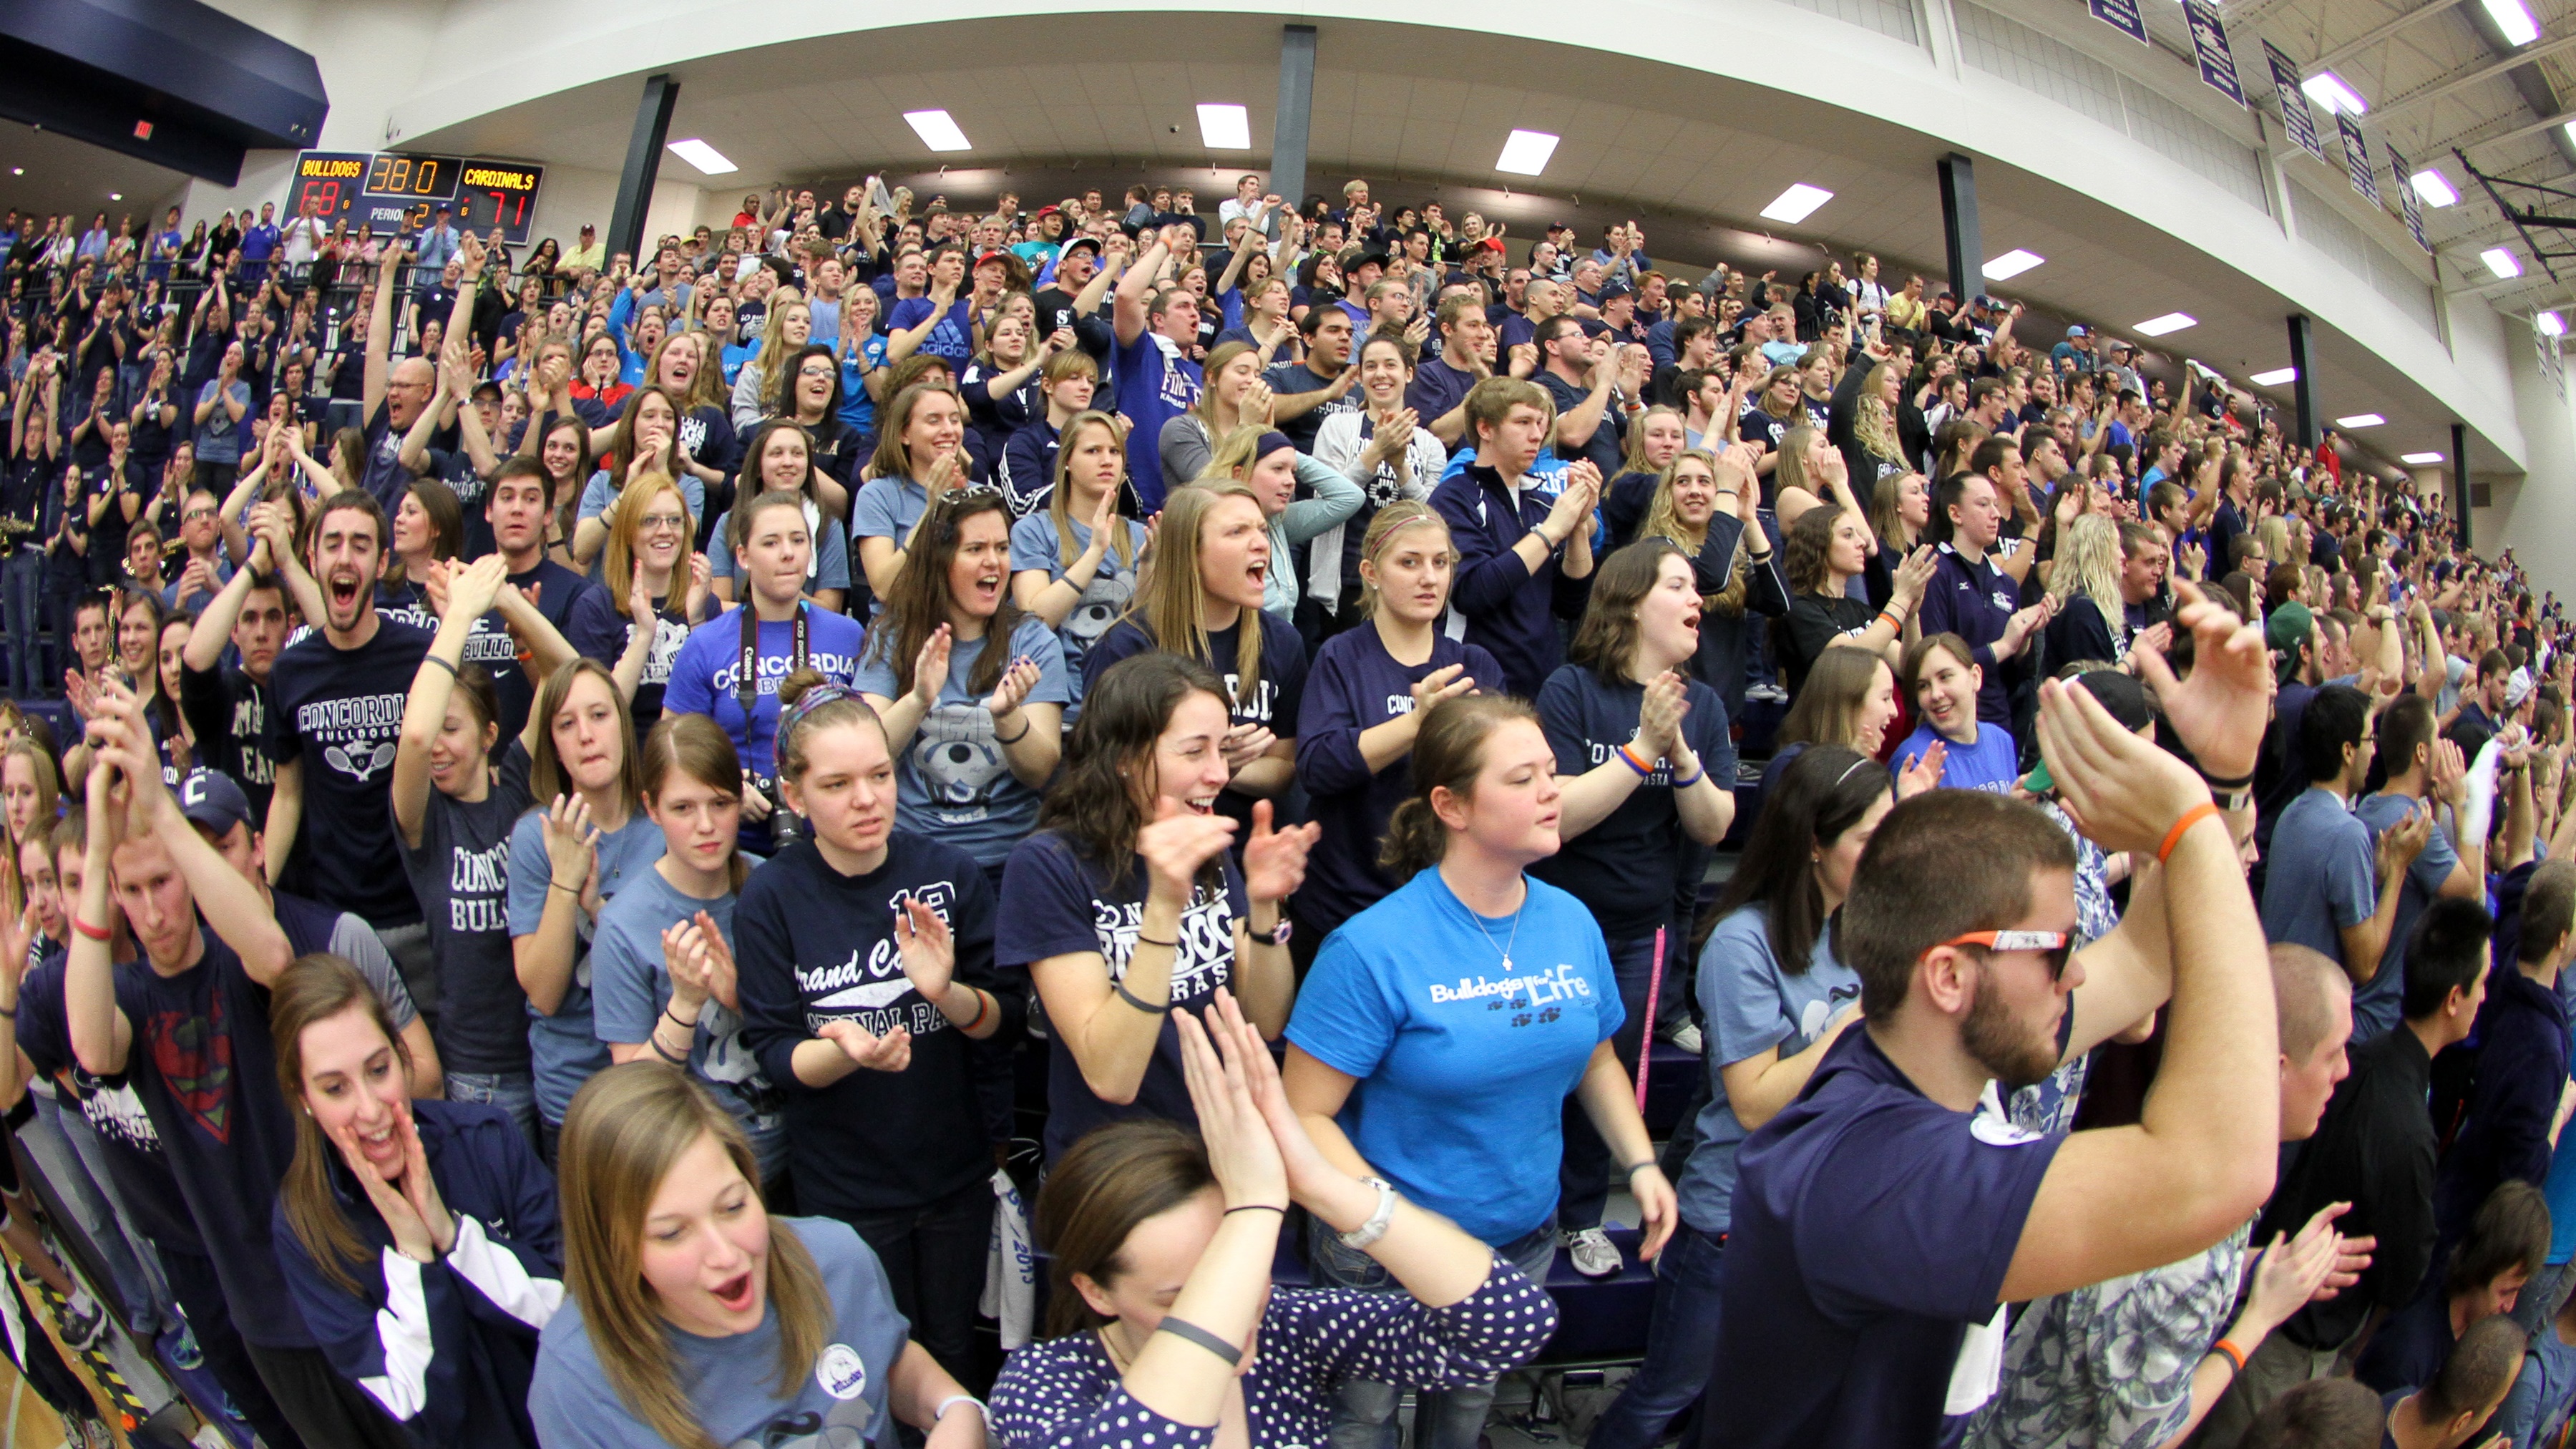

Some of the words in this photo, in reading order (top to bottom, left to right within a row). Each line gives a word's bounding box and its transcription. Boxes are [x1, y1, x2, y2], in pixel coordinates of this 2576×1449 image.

[301, 160, 362, 177] BULLDOGS
[370, 158, 438, 194] 38.0
[464, 168, 535, 190] CARDINALS
[370, 207, 408, 222] PERIO
[489, 191, 526, 226] 71
[298, 693, 411, 733] CONCORDI
[184, 774, 208, 807] C
[1430, 975, 1525, 1003] Bulldogs
[1523, 963, 1591, 1007] Life
[1533, 975, 1549, 987] for
